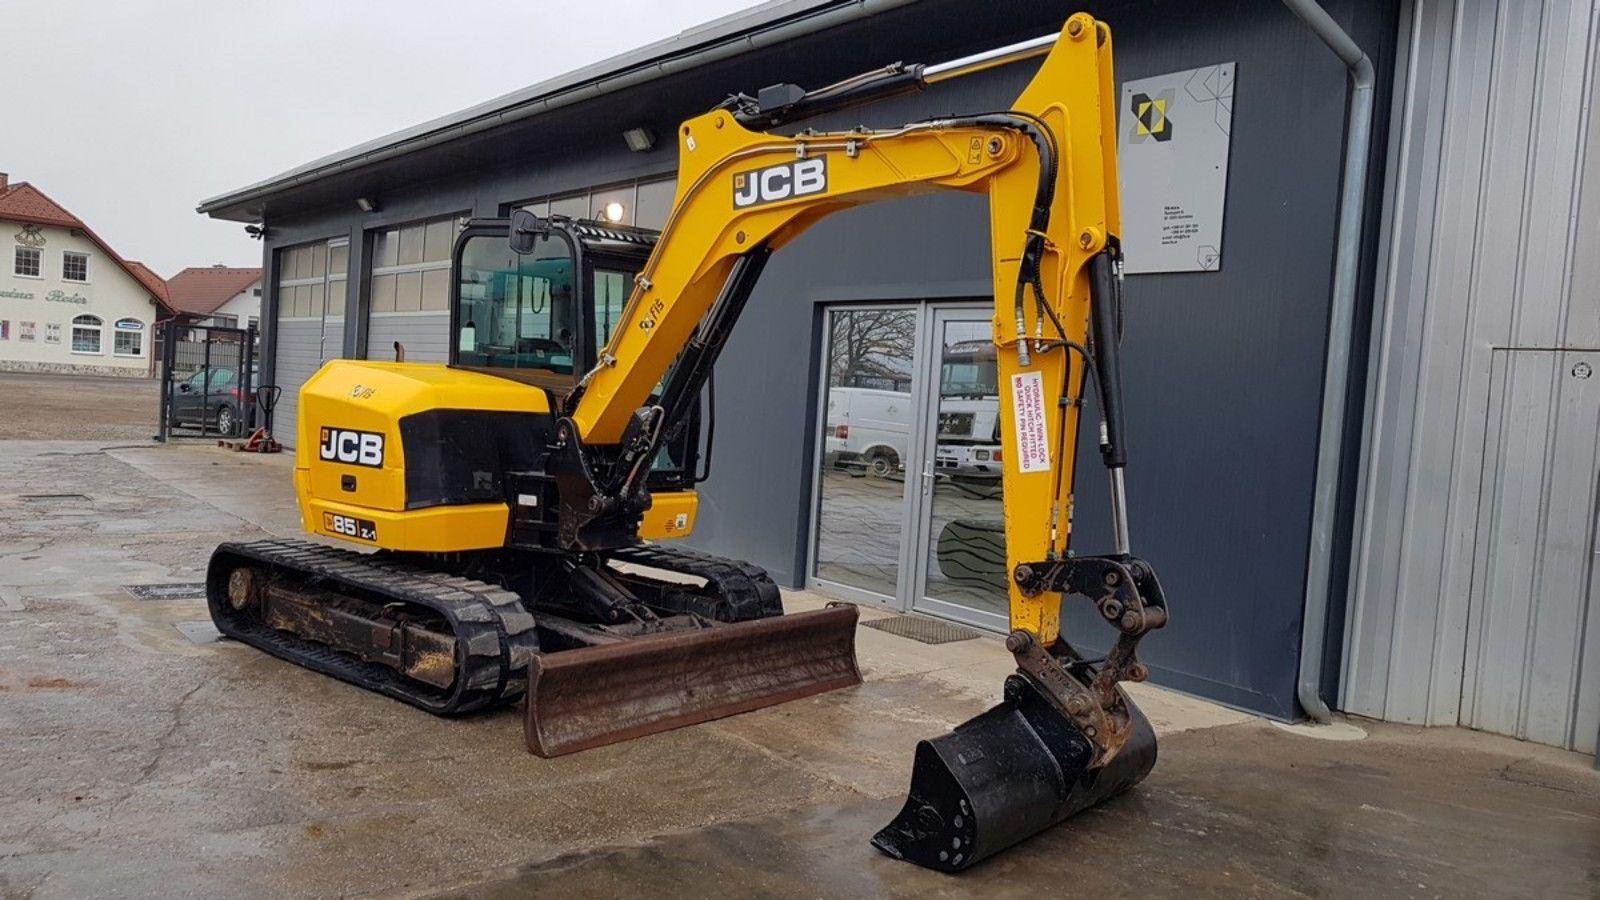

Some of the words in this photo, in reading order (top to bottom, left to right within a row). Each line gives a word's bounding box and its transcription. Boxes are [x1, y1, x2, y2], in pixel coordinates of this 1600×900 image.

[735, 159, 825, 206] JCB
[1015, 376, 1022, 388] NO
[1017, 389, 1025, 417] SAFETY
[1024, 385, 1032, 409] QUICK
[1027, 410, 1035, 432] HITCH
[320, 429, 383, 466] JCB
[1021, 432, 1030, 469] REQUIRED
[334, 515, 357, 536] 85
